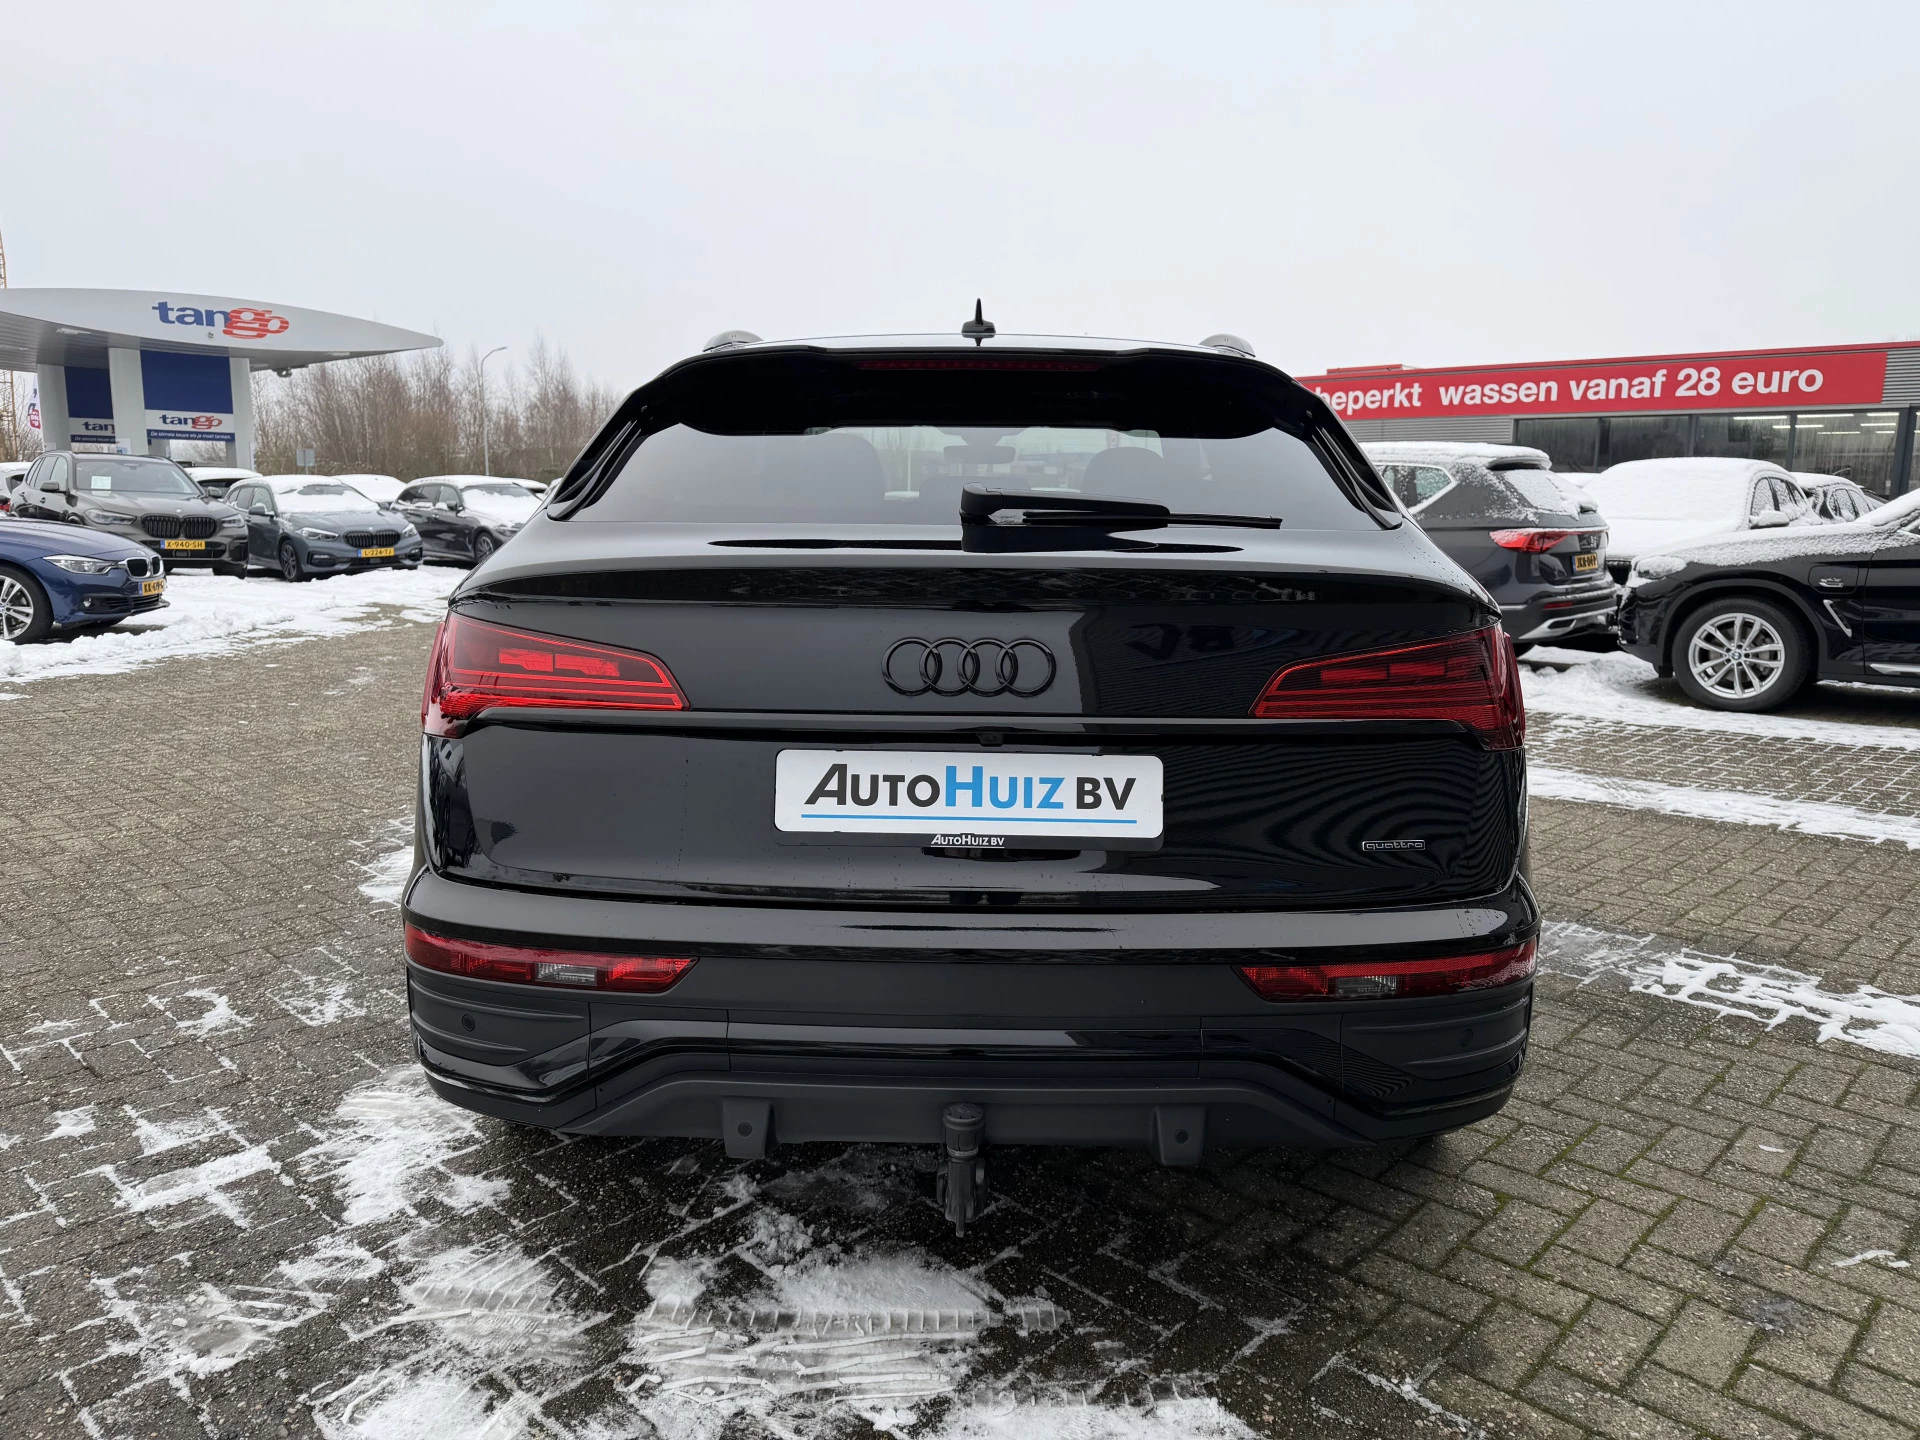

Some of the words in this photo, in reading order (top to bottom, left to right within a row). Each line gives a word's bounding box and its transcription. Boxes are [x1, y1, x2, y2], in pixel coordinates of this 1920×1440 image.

[152, 301, 289, 339] tango
[1439, 381, 1558, 407] wassen
[1569, 369, 1667, 400] vanaf
[1675, 367, 1721, 396] 28
[1731, 368, 1824, 395] euro
[82, 421, 115, 434] tan
[159, 414, 223, 430] tango
[1076, 777, 1136, 810] BV
[990, 837, 1005, 845] BV
[1366, 841, 1423, 850] quattro
